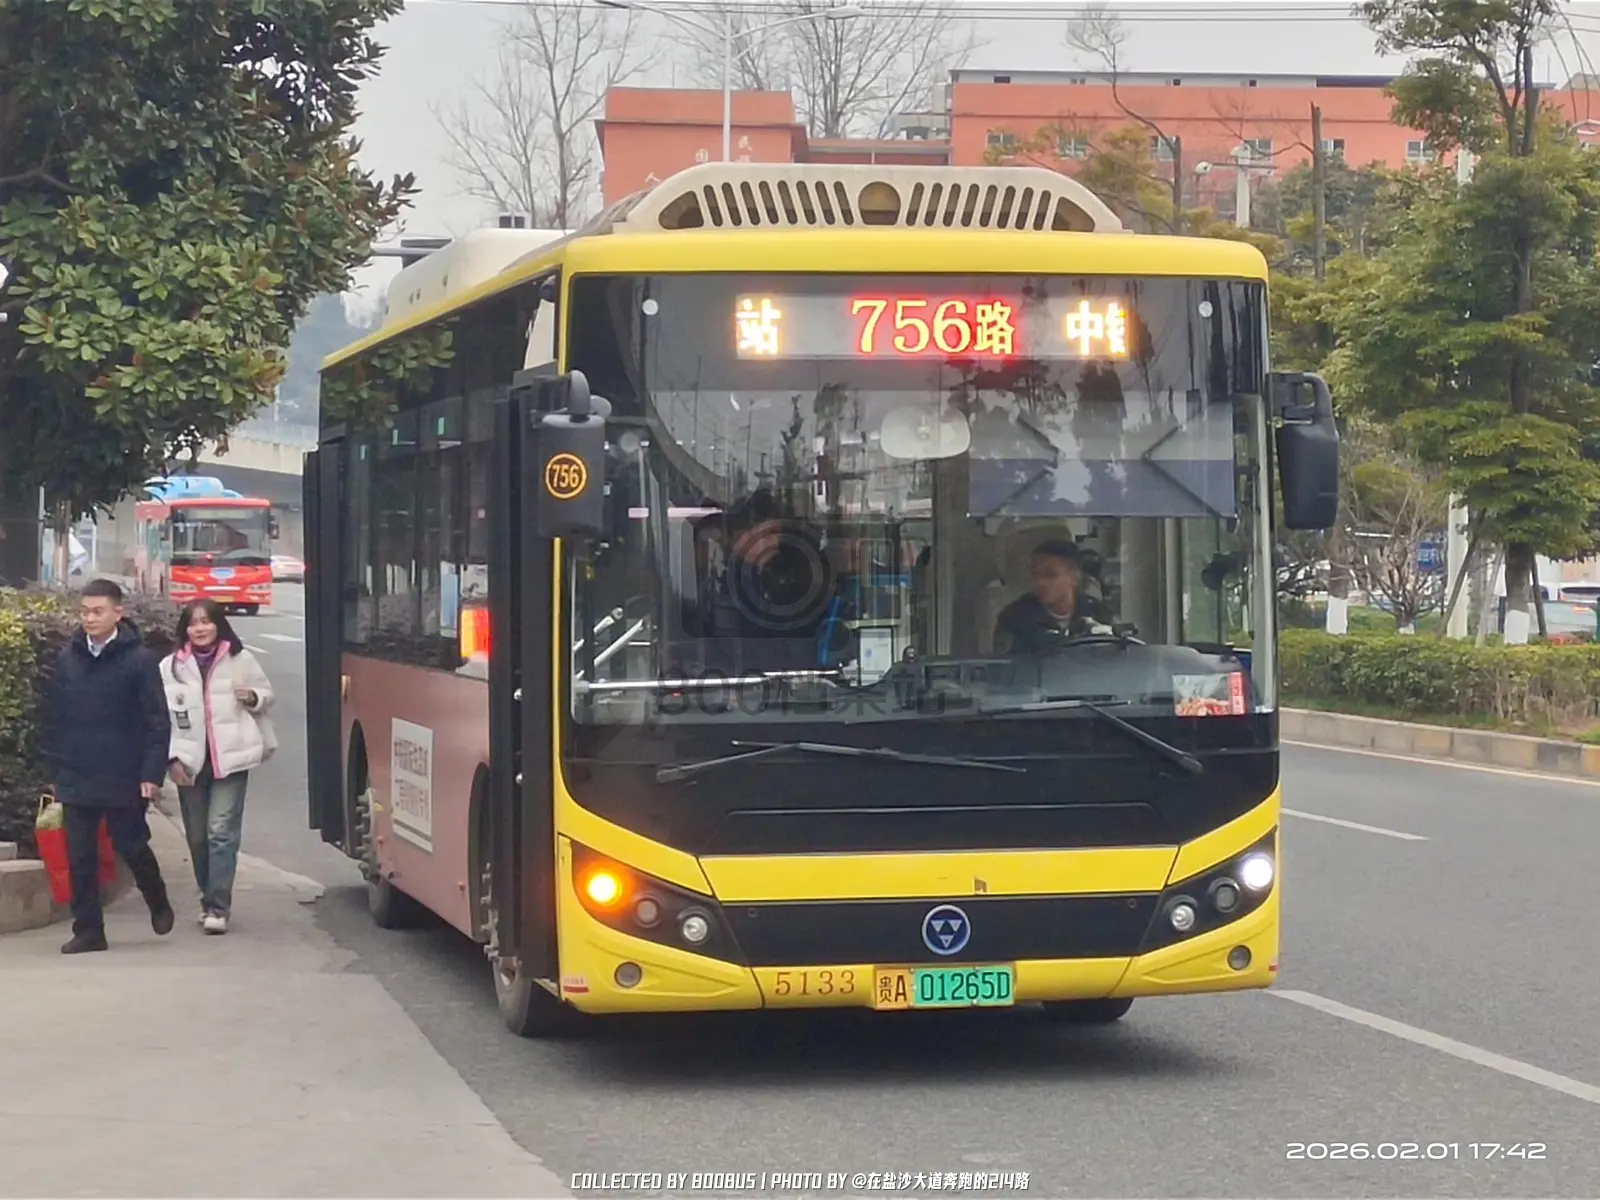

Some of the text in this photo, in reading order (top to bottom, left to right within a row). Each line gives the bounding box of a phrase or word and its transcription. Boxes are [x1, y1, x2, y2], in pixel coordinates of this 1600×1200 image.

[736, 299, 780, 355] 站
[851, 299, 1015, 356] 756路
[552, 464, 580, 488] 756
[774, 971, 855, 996] 5133
